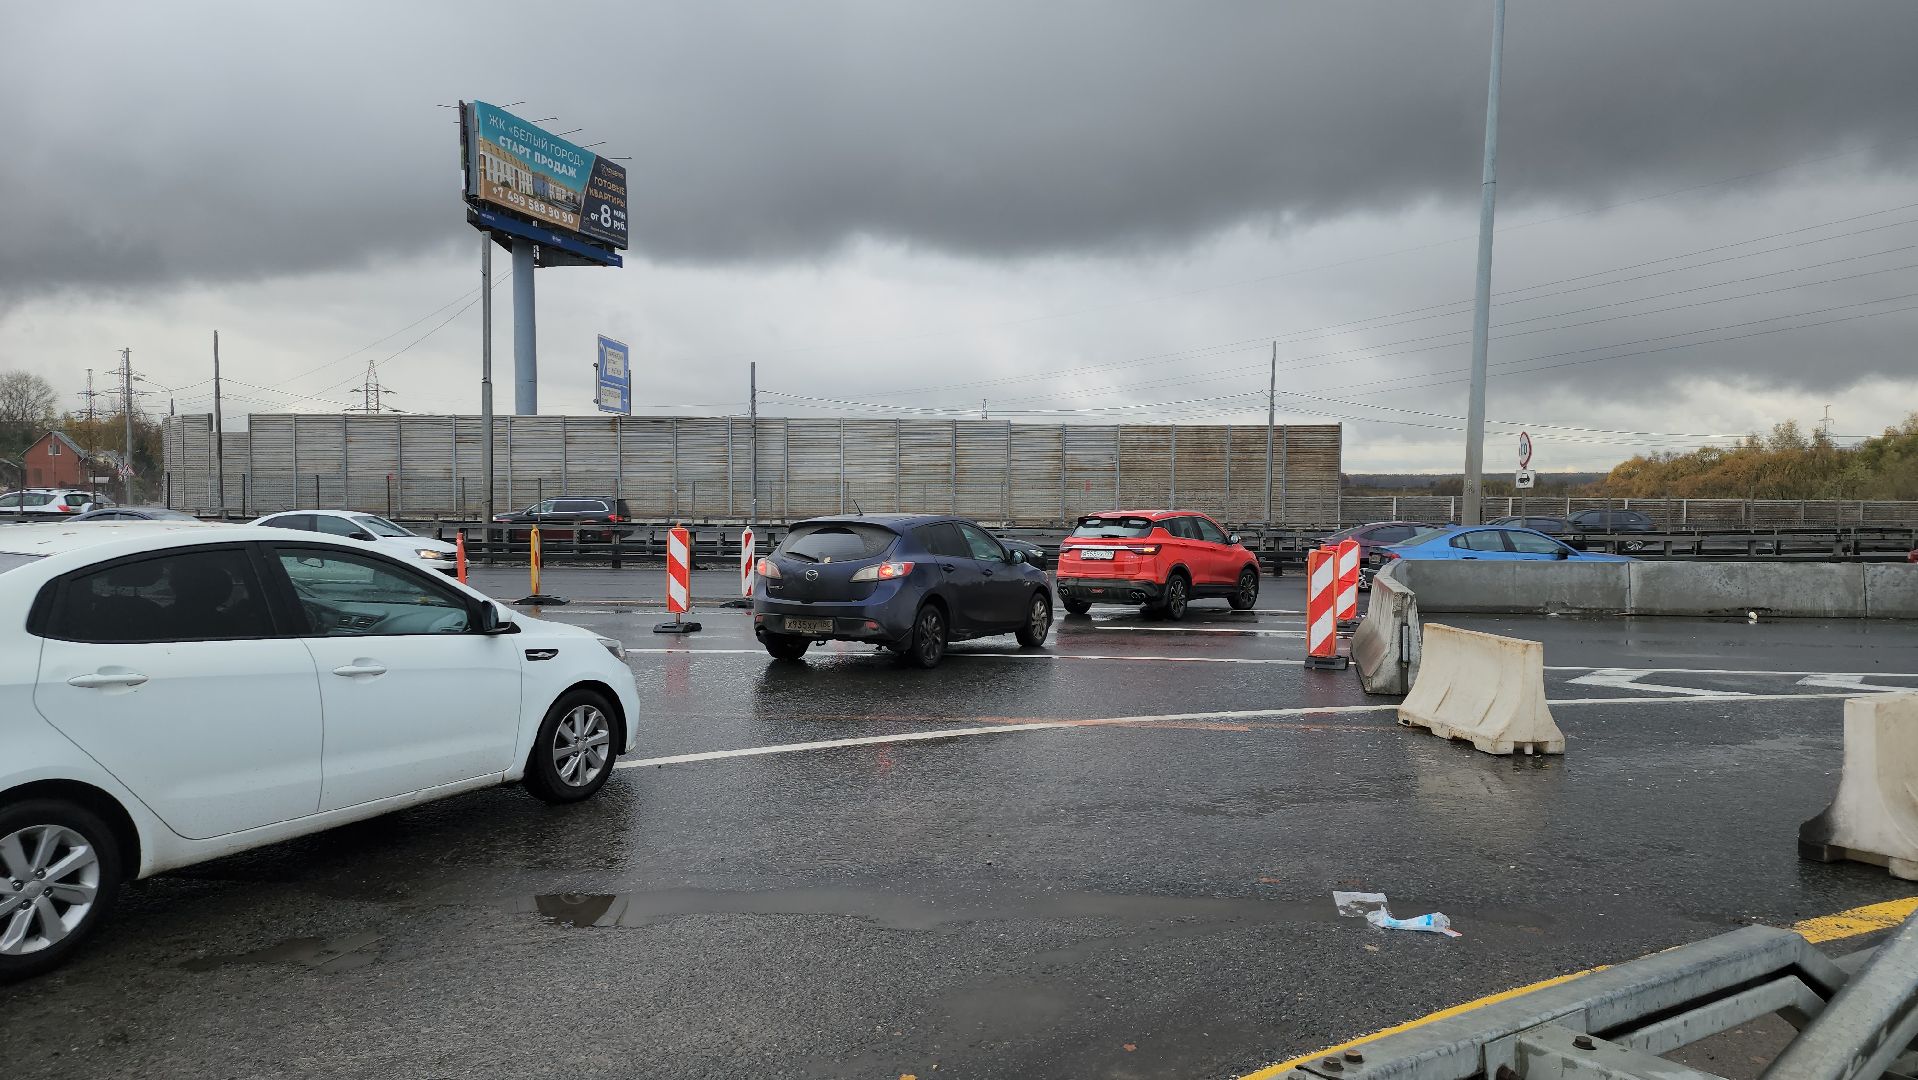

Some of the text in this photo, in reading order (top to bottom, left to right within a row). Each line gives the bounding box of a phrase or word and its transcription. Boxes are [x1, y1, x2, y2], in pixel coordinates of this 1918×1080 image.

[489, 113, 585, 168] ЖК «БЕЛЫЙ ГОРОД»
[499, 135, 531, 159] СТАРТ
[534, 151, 577, 179] ПРОДАЖ
[588, 187, 626, 209] КВАРТИРЫ
[594, 176, 625, 196] ГОТОВЫЕ
[492, 186, 574, 224] +7 499 588 90 90
[590, 203, 626, 228] от 8 млн
[613, 219, 626, 231] руб.
